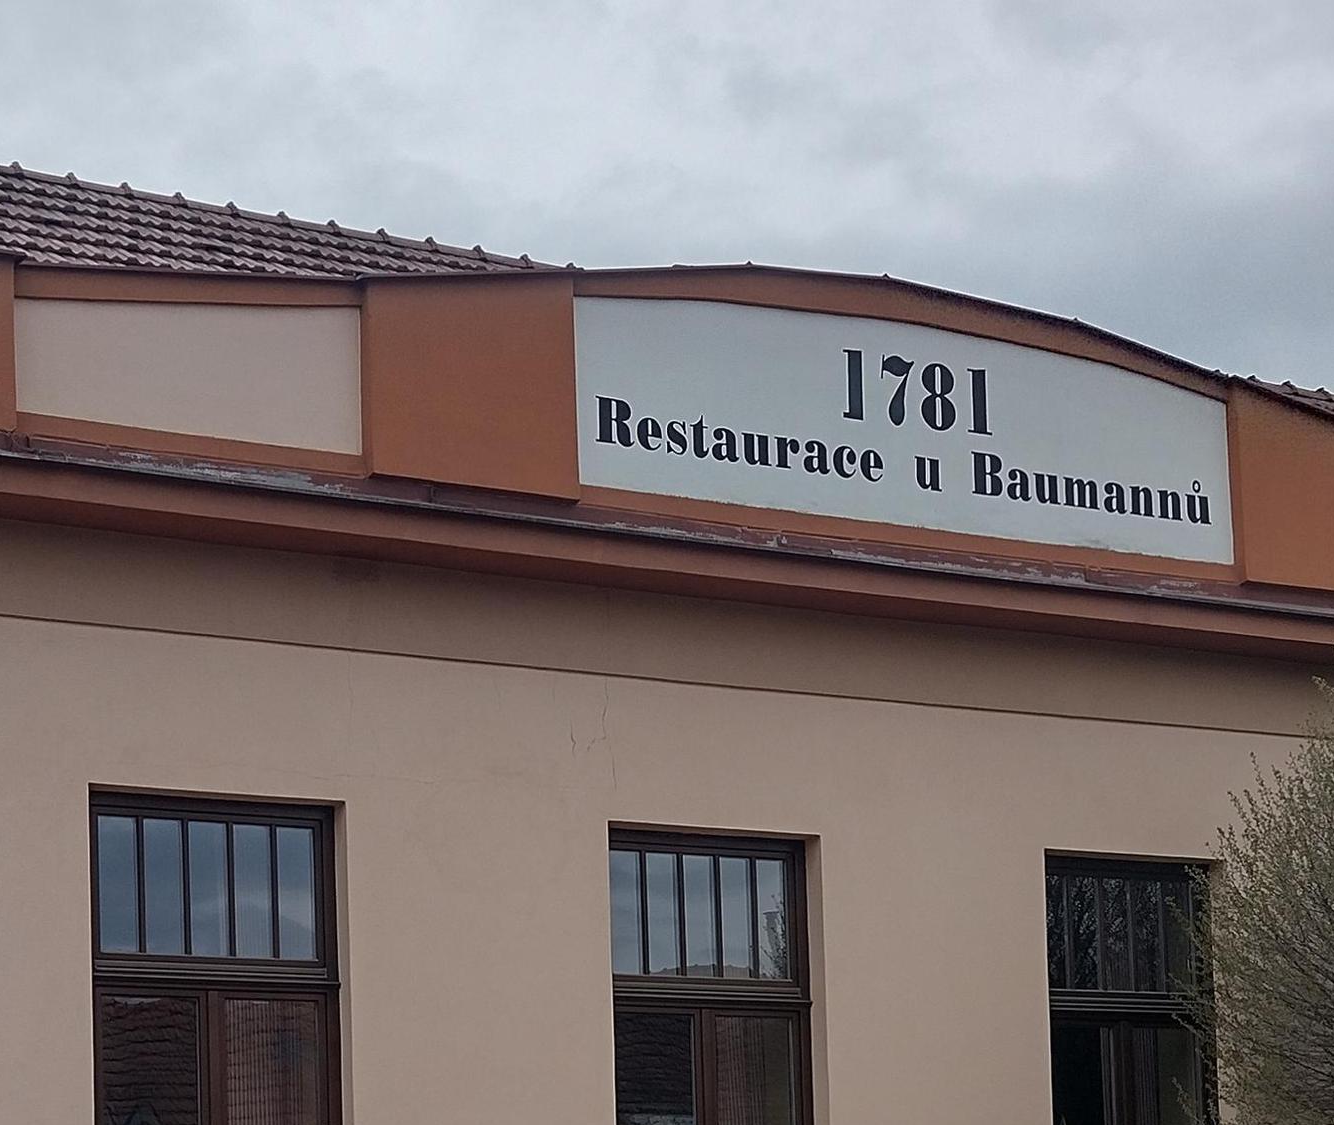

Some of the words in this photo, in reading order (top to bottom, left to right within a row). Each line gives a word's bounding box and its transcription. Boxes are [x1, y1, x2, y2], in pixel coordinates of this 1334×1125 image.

[842, 348, 994, 437] 1781
[594, 394, 885, 484] Restaurace
[913, 454, 944, 494] u
[969, 449, 1213, 526] Baumannů
